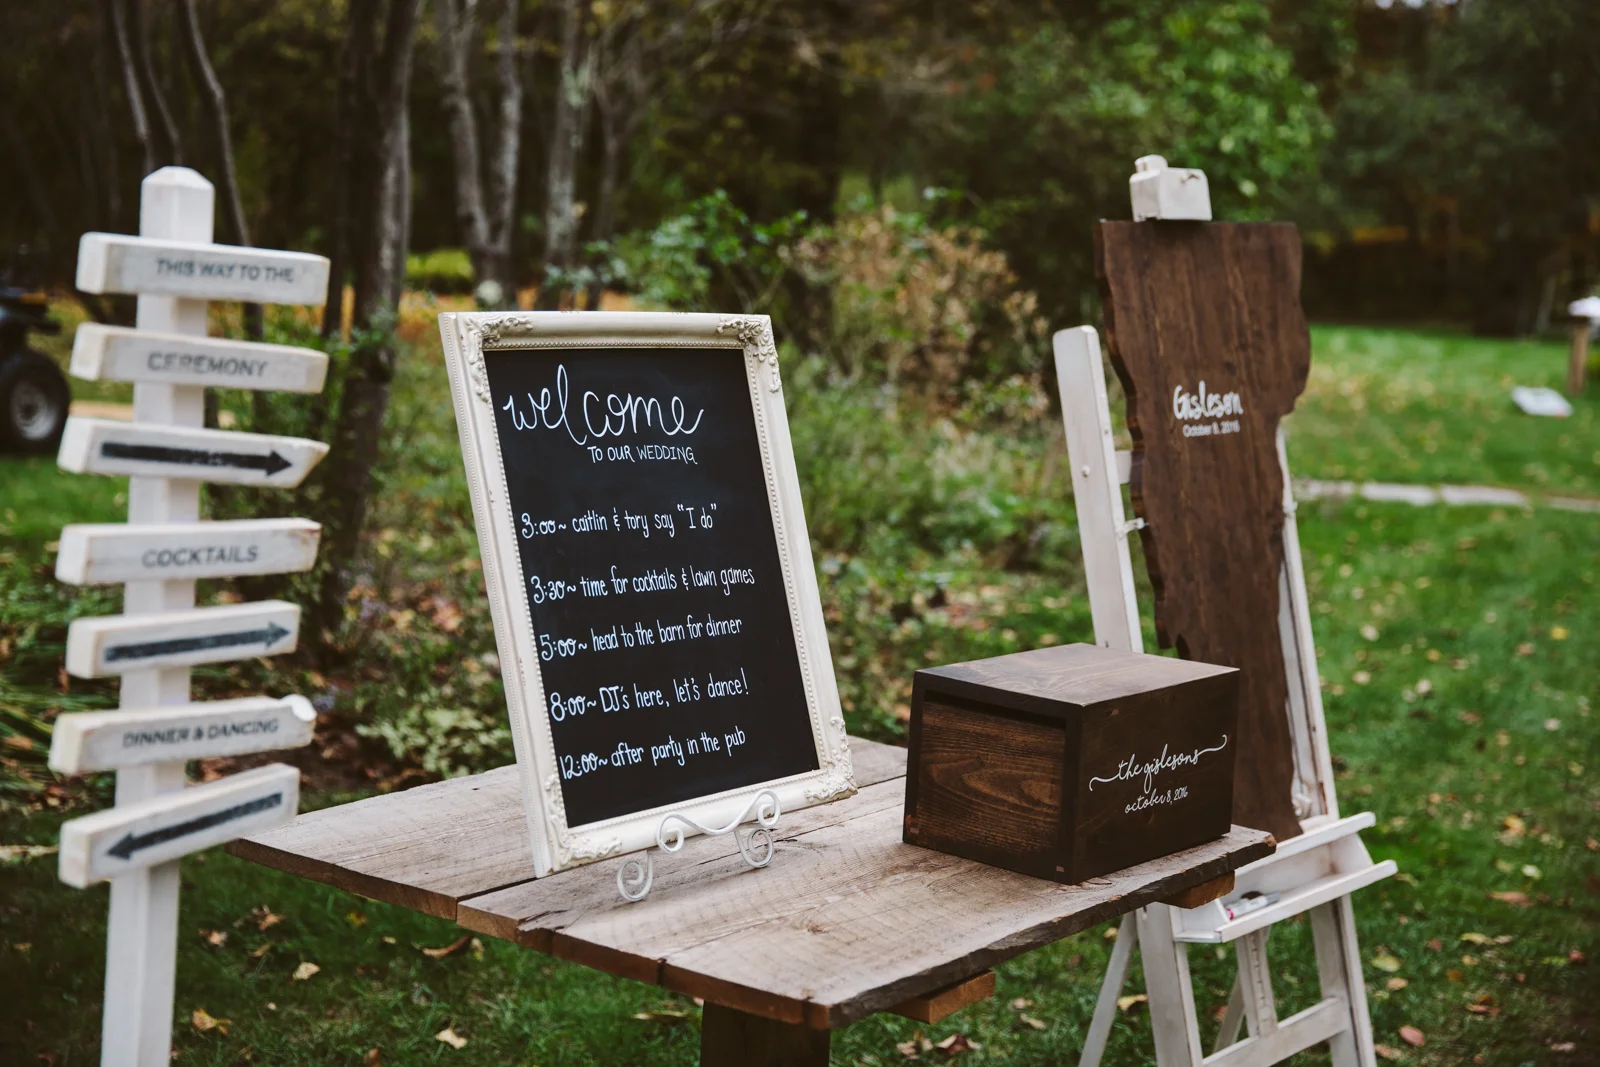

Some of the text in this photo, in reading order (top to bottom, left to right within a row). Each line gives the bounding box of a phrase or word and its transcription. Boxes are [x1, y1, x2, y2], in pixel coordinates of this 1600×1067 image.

[156, 258, 295, 283] THIS WAY TO THE
[147, 351, 268, 377] CEREMONY
[587, 444, 698, 465] TO OUR WEDDING
[572, 510, 608, 533] caitlin
[624, 509, 650, 538] tory
[654, 513, 675, 538] say
[142, 545, 259, 569] COCKTAILS
[580, 576, 609, 597] time
[611, 565, 628, 594] for
[632, 567, 678, 593] cocktails
[690, 565, 717, 588] lawn
[720, 567, 756, 596] games
[591, 625, 620, 652] head
[621, 625, 635, 648] to
[635, 621, 656, 646] the
[656, 619, 686, 644] barn
[686, 614, 703, 640] for
[706, 613, 743, 638] dinner
[599, 685, 631, 712] DJ's
[633, 682, 671, 708] here,
[673, 676, 701, 703] let's
[707, 667, 750, 698] dance!
[123, 719, 279, 747] DINNER & DANCING
[610, 742, 644, 767] after
[650, 735, 684, 767] party
[687, 736, 700, 755] in
[700, 731, 721, 754] the
[724, 725, 746, 757] pub
[1124, 788, 1167, 814] october
[1173, 785, 1189, 801] 2016
